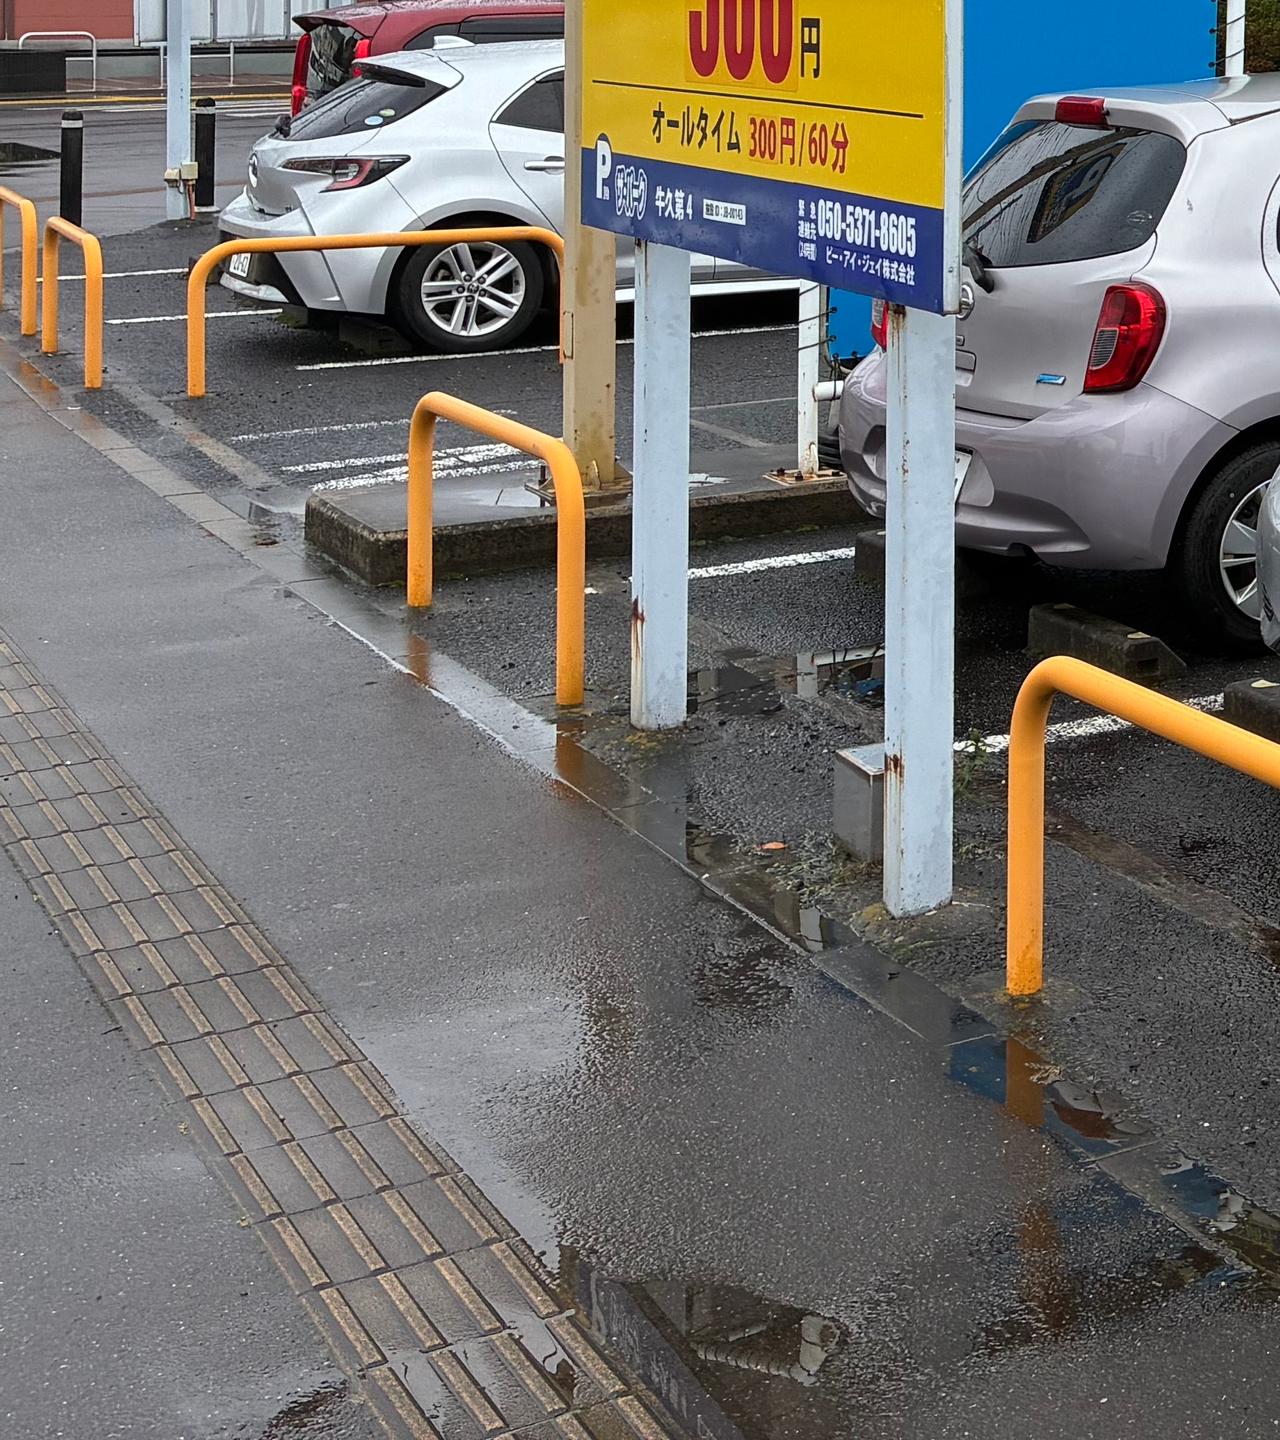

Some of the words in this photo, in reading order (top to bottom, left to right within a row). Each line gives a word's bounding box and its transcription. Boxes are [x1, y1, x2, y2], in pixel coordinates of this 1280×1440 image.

[652, 101, 741, 154] オールタイム
[749, 117, 849, 174] 300円/60分
[596, 140, 612, 199] P
[655, 186, 693, 221] 牛久第4
[818, 199, 916, 257] 050-5371-8605
[826, 245, 915, 285] ビー・アイ・ジェイ株式会社
